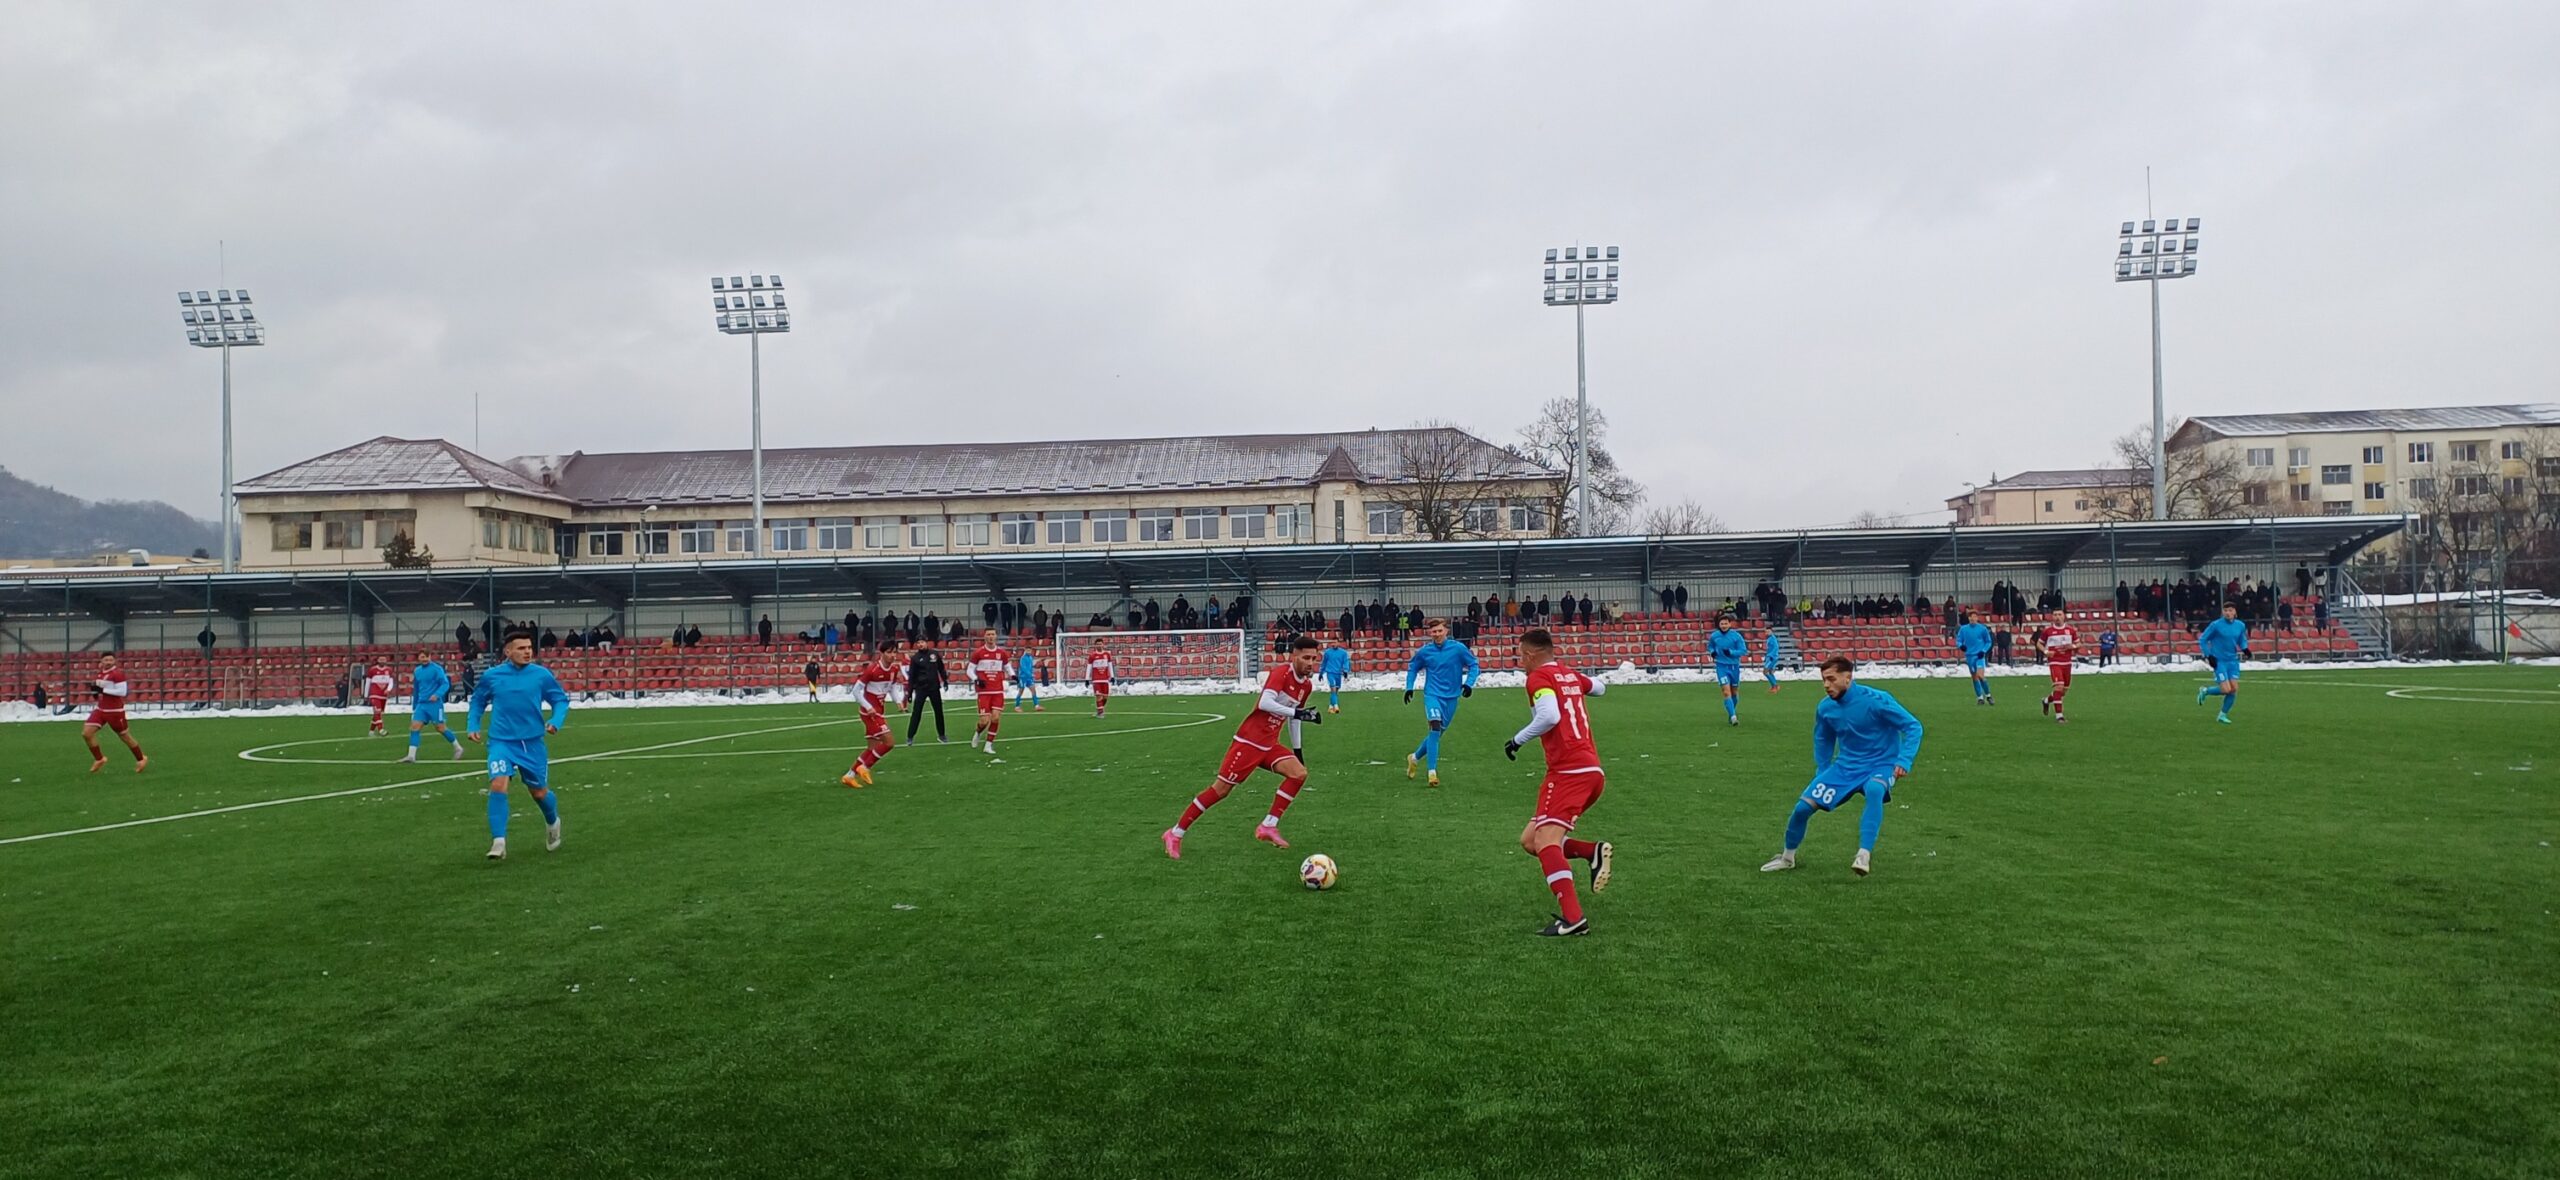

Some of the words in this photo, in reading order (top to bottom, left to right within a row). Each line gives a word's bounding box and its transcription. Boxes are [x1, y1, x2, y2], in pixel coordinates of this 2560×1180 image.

[1564, 696, 1589, 739] 11
[1228, 772, 1238, 781] 17
[1812, 783, 1836, 804] 36
